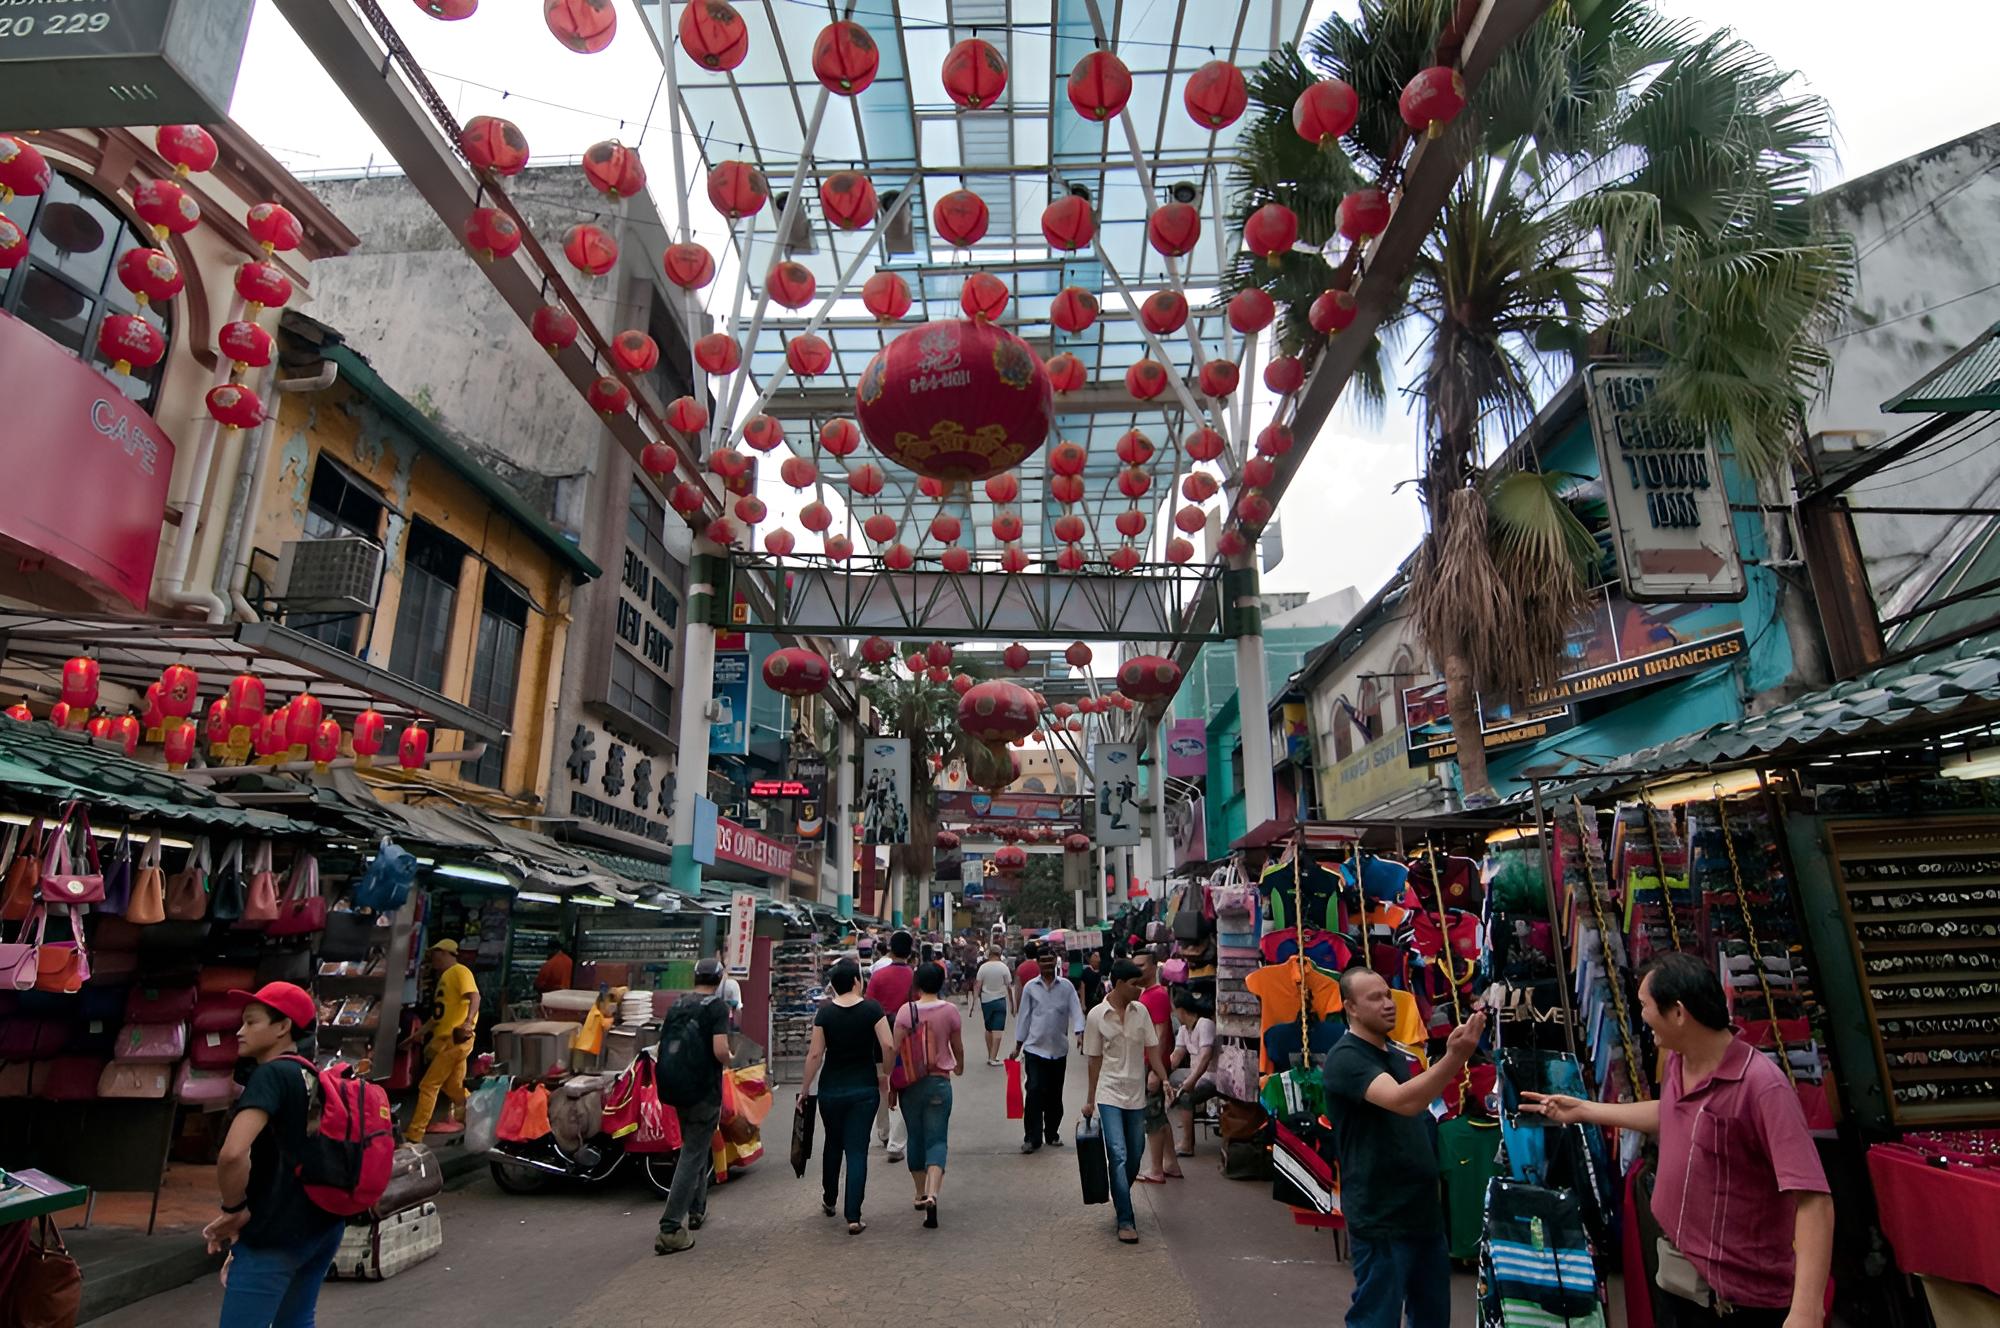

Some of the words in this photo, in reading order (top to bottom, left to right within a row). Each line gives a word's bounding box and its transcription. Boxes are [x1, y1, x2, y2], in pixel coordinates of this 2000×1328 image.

[43, 12, 111, 35] 229
[91, 398, 158, 476] CAFE
[1622, 453, 1711, 490] TOWN
[1646, 491, 1701, 528] INN
[1574, 666, 1641, 693] LUMPUR
[1643, 639, 1741, 677] BRANCHES
